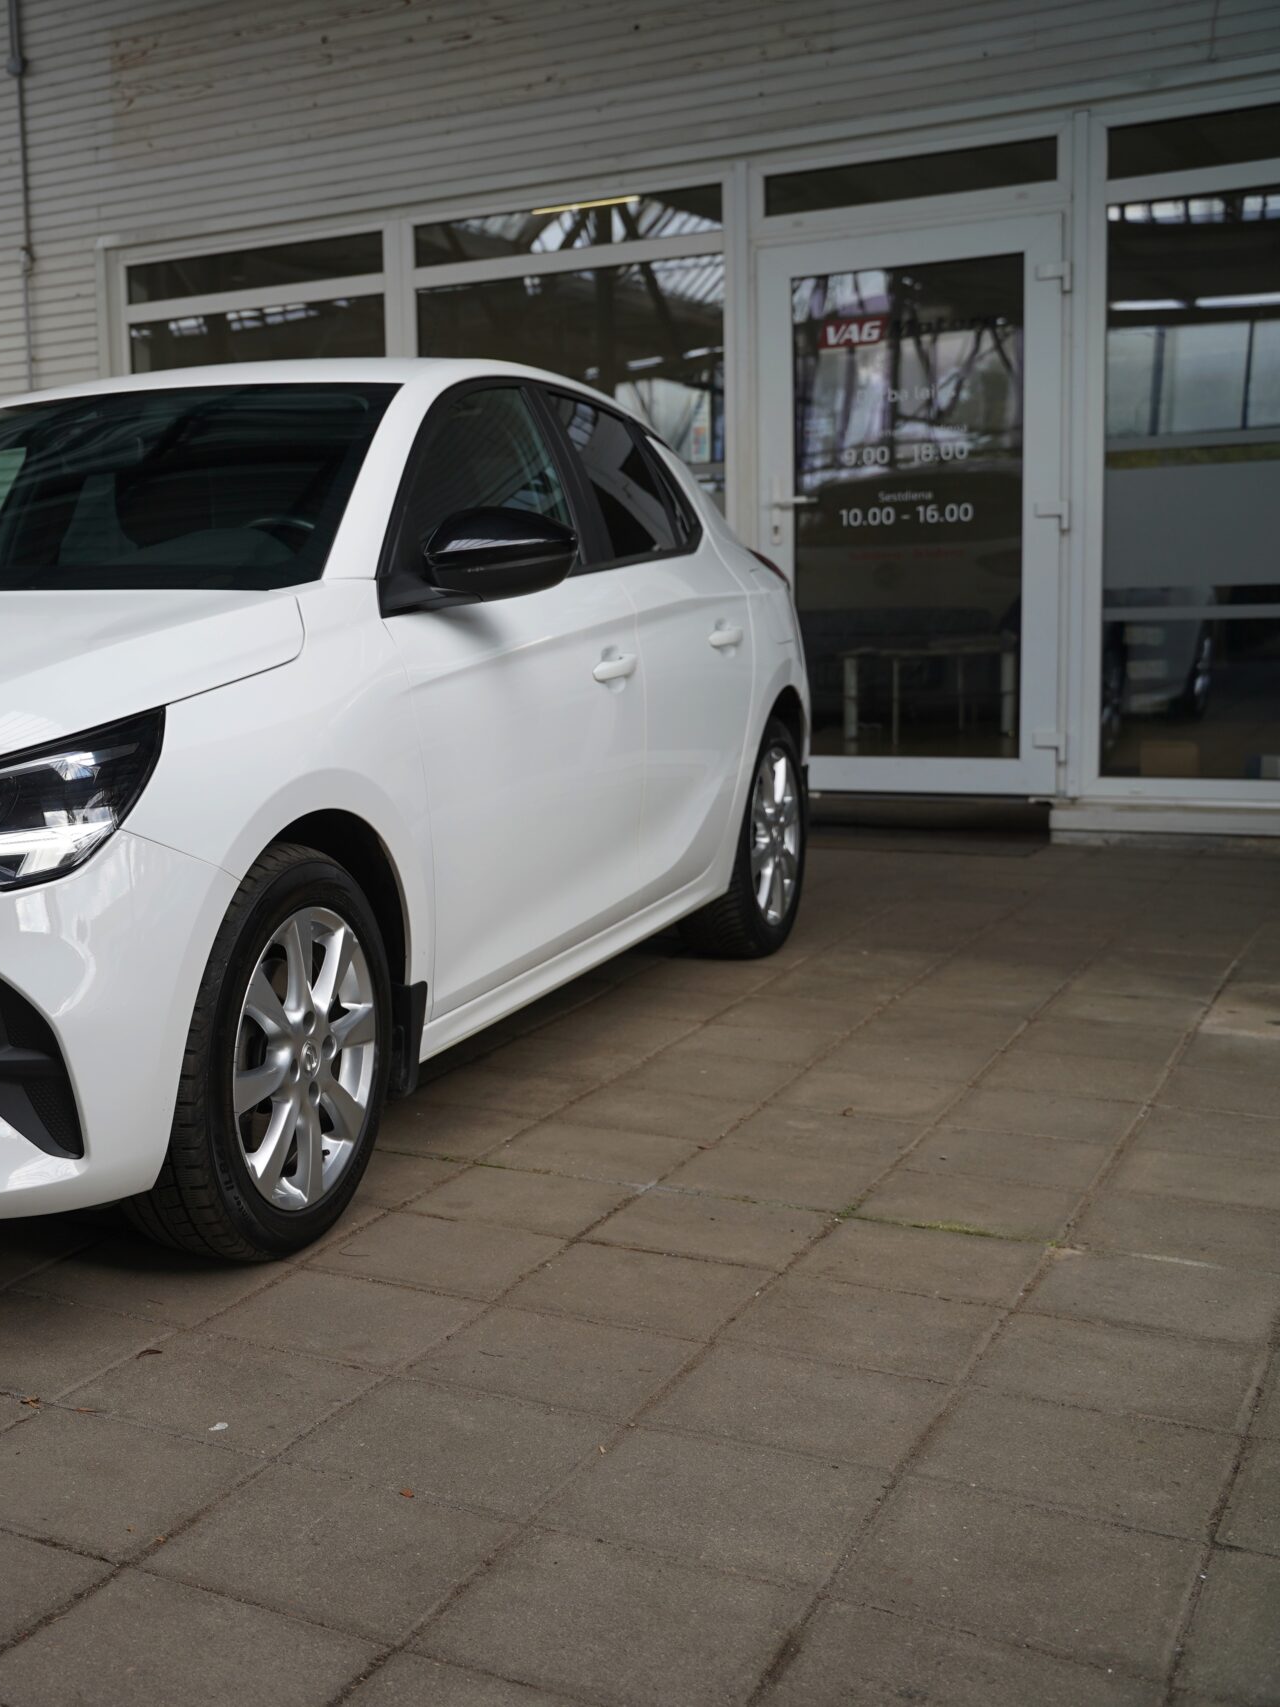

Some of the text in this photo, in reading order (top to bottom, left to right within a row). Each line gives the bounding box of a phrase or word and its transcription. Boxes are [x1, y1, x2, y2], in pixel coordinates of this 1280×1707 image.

[826, 320, 881, 346] VAG
[844, 446, 890, 466] 9.00
[913, 441, 969, 464] 18.00
[839, 506, 896, 527] 10.00
[916, 502, 974, 524] 16.00
